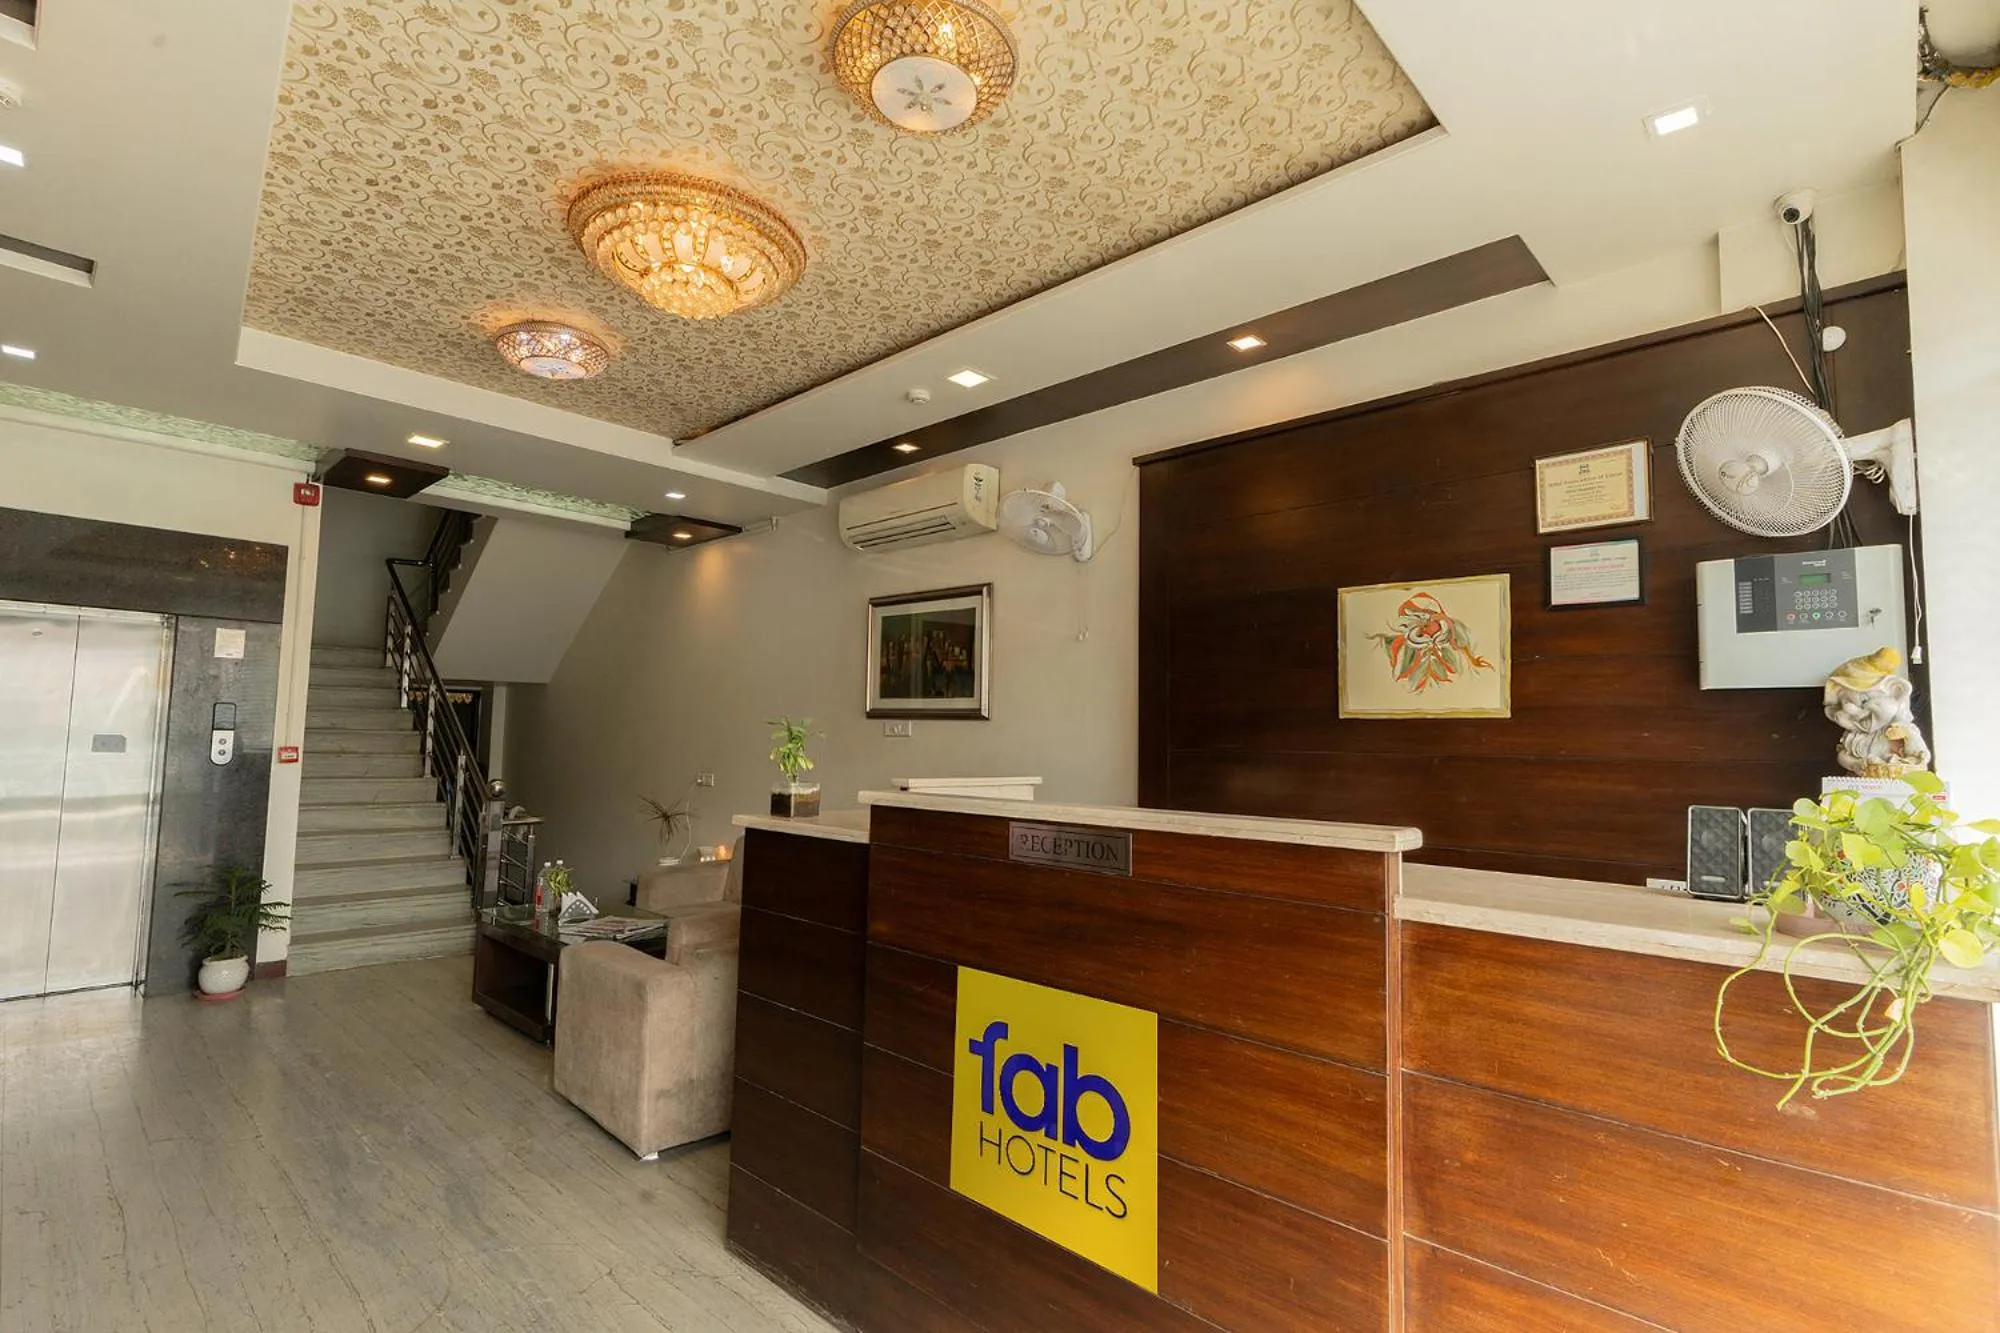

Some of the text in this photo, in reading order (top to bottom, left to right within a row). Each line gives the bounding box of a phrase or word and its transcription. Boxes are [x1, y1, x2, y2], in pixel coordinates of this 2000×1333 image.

[1020, 834, 1119, 862] RECEPTION
[968, 1020, 1131, 1162] fab
[979, 1120, 1128, 1219] HOTELS
